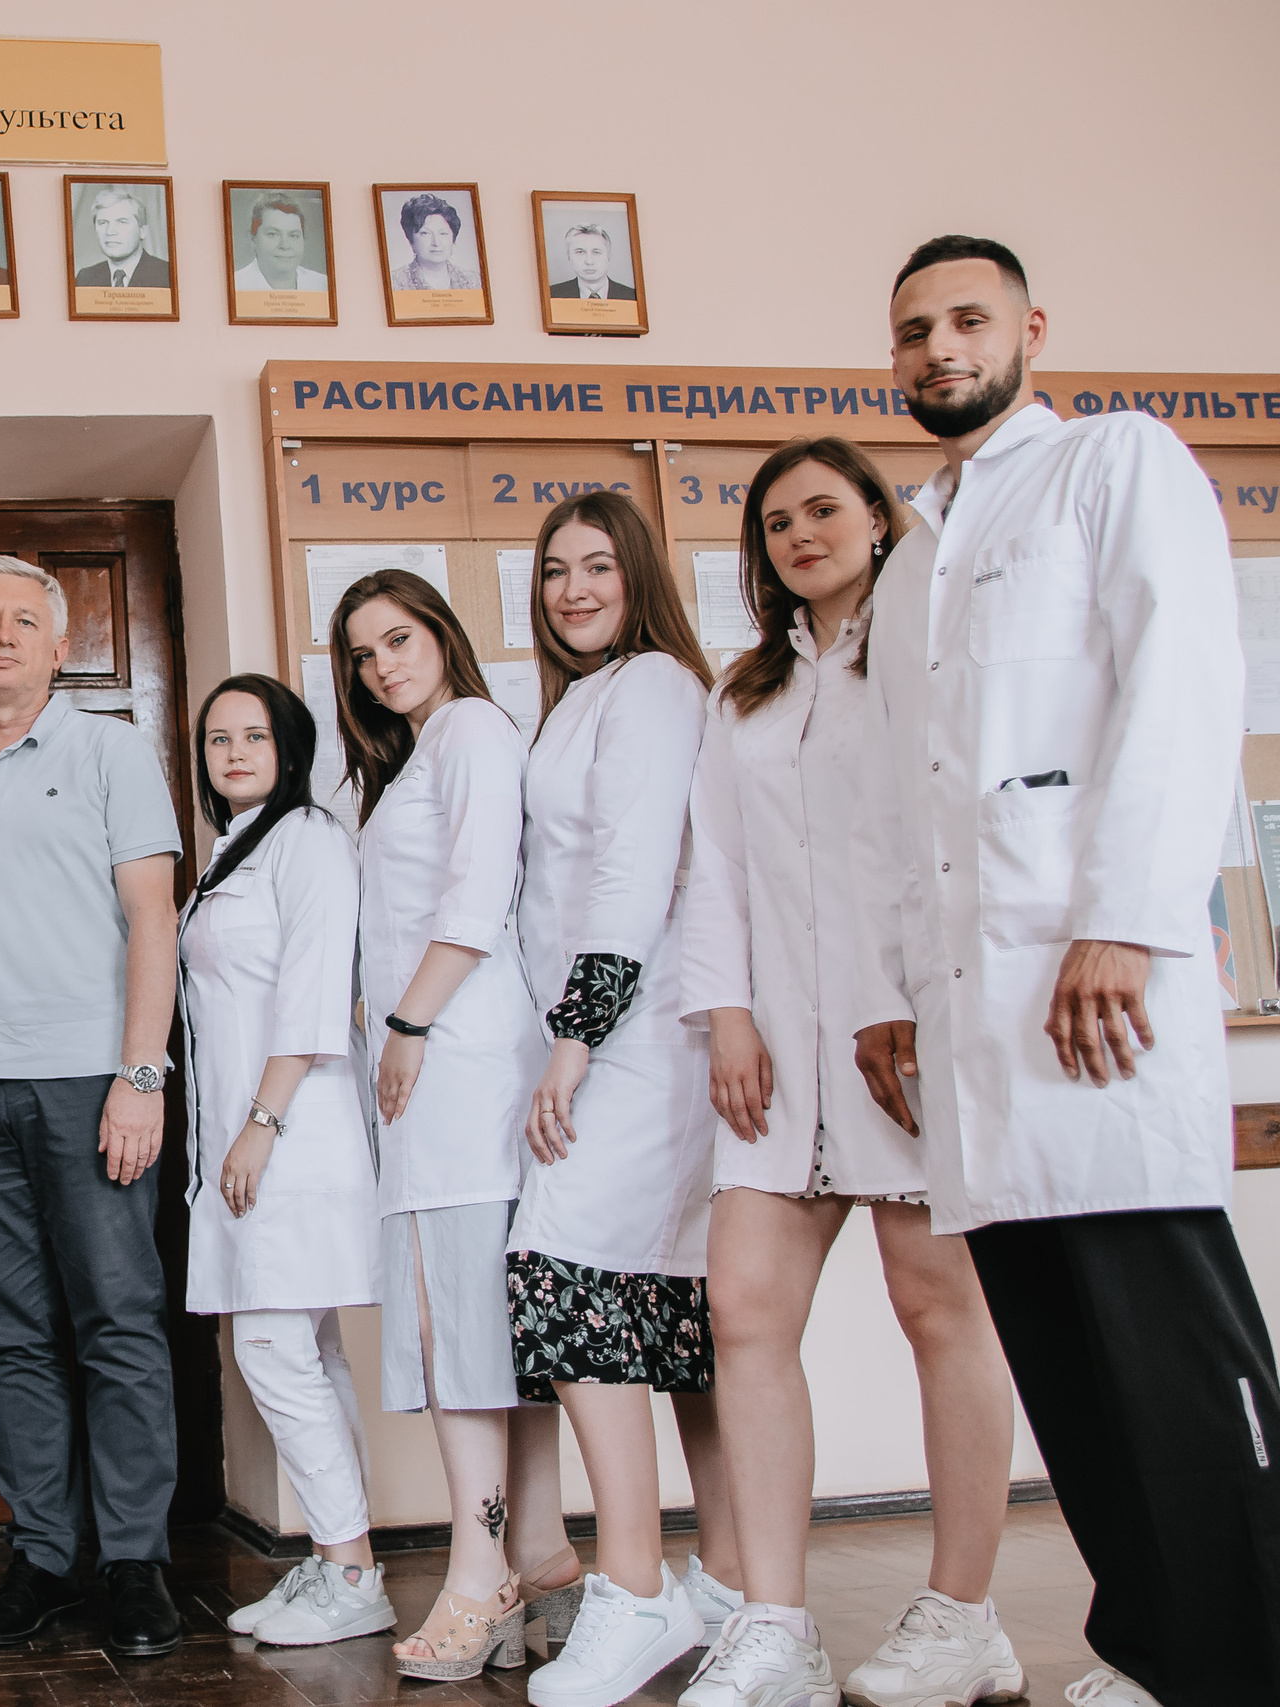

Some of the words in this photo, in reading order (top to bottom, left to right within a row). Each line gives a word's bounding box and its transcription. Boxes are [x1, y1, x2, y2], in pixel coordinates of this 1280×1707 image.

[102, 290, 146, 300] Тараканов
[294, 381, 605, 413] РАСПИСАНИЕ
[303, 475, 322, 505] 1
[343, 482, 446, 513] курс
[492, 473, 519, 503] 2
[679, 475, 704, 505] 3
[1254, 1440, 1266, 1462] NIKE
